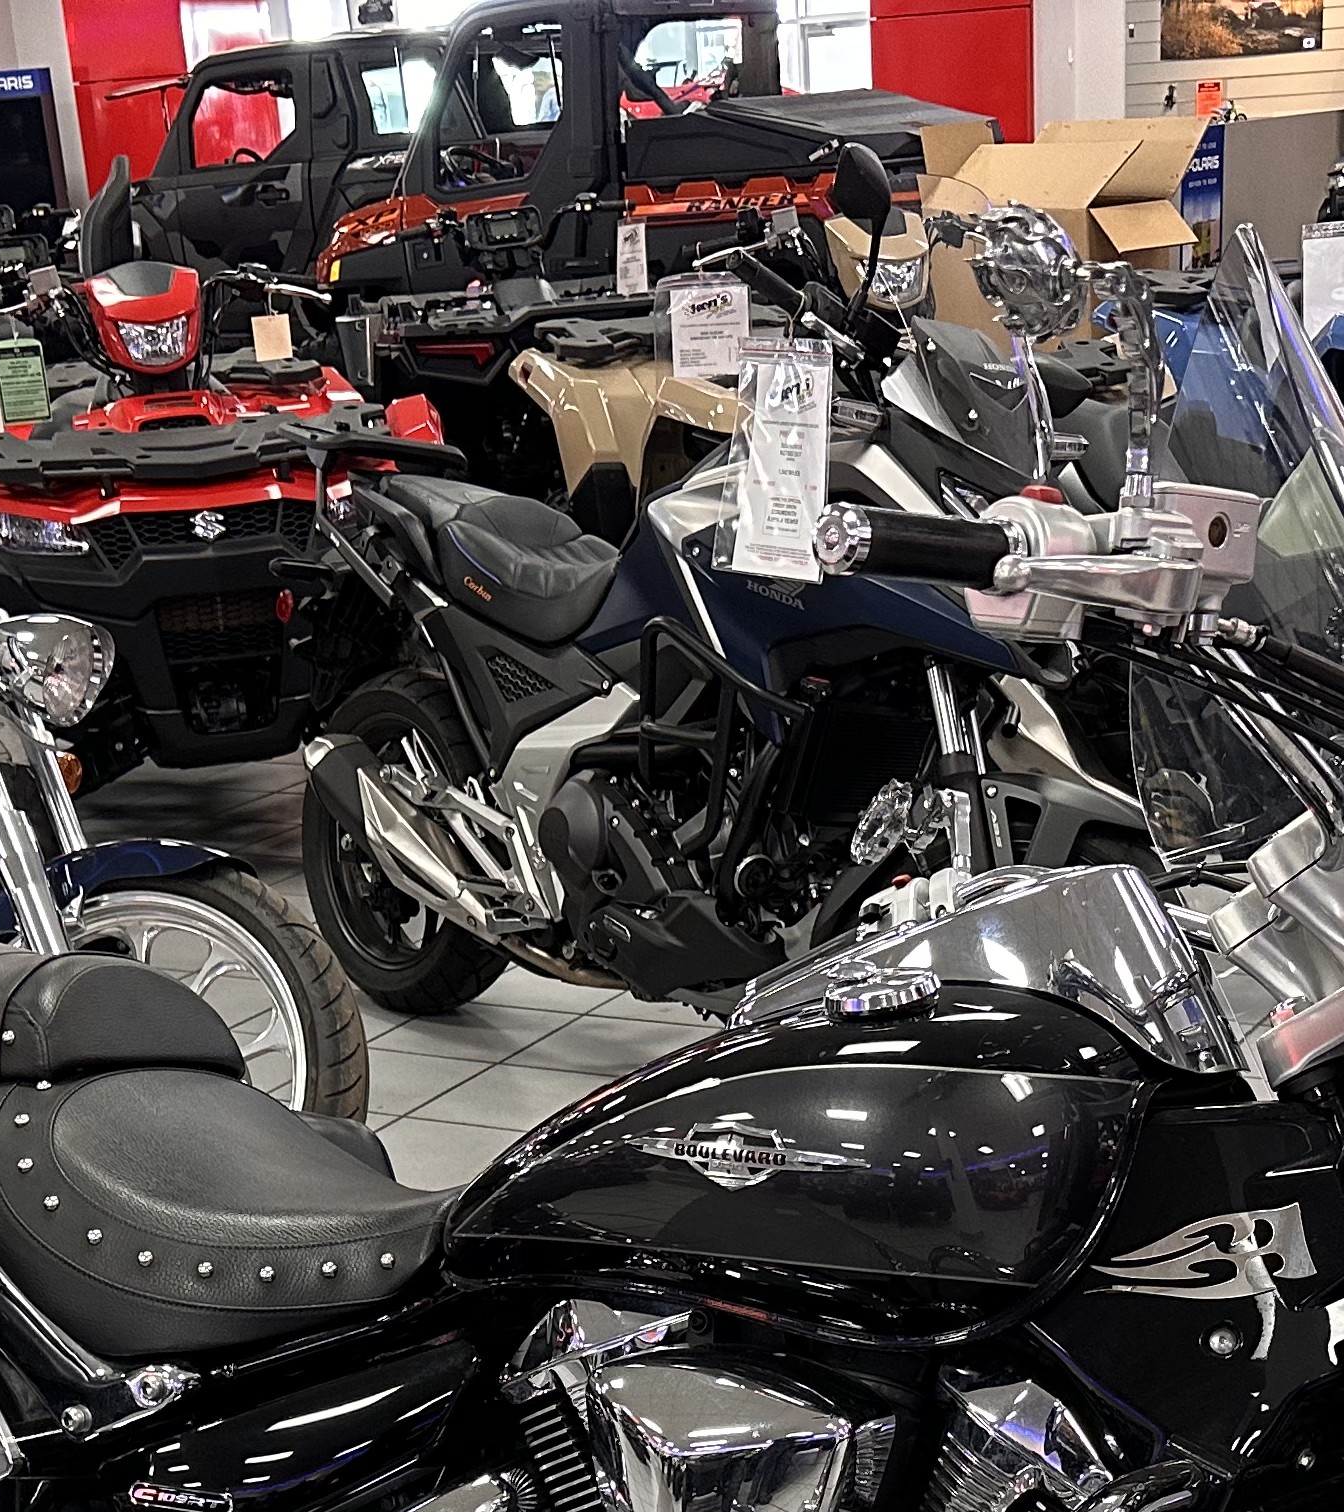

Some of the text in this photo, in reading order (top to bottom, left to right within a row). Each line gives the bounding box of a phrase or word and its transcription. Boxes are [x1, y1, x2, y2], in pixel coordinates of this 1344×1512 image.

[685, 192, 796, 212] RANGER
[464, 576, 492, 602] Corbin
[746, 580, 805, 611] HONDA
[674, 1142, 787, 1167] BOULEVARD
[133, 1488, 226, 1510] C109RT
